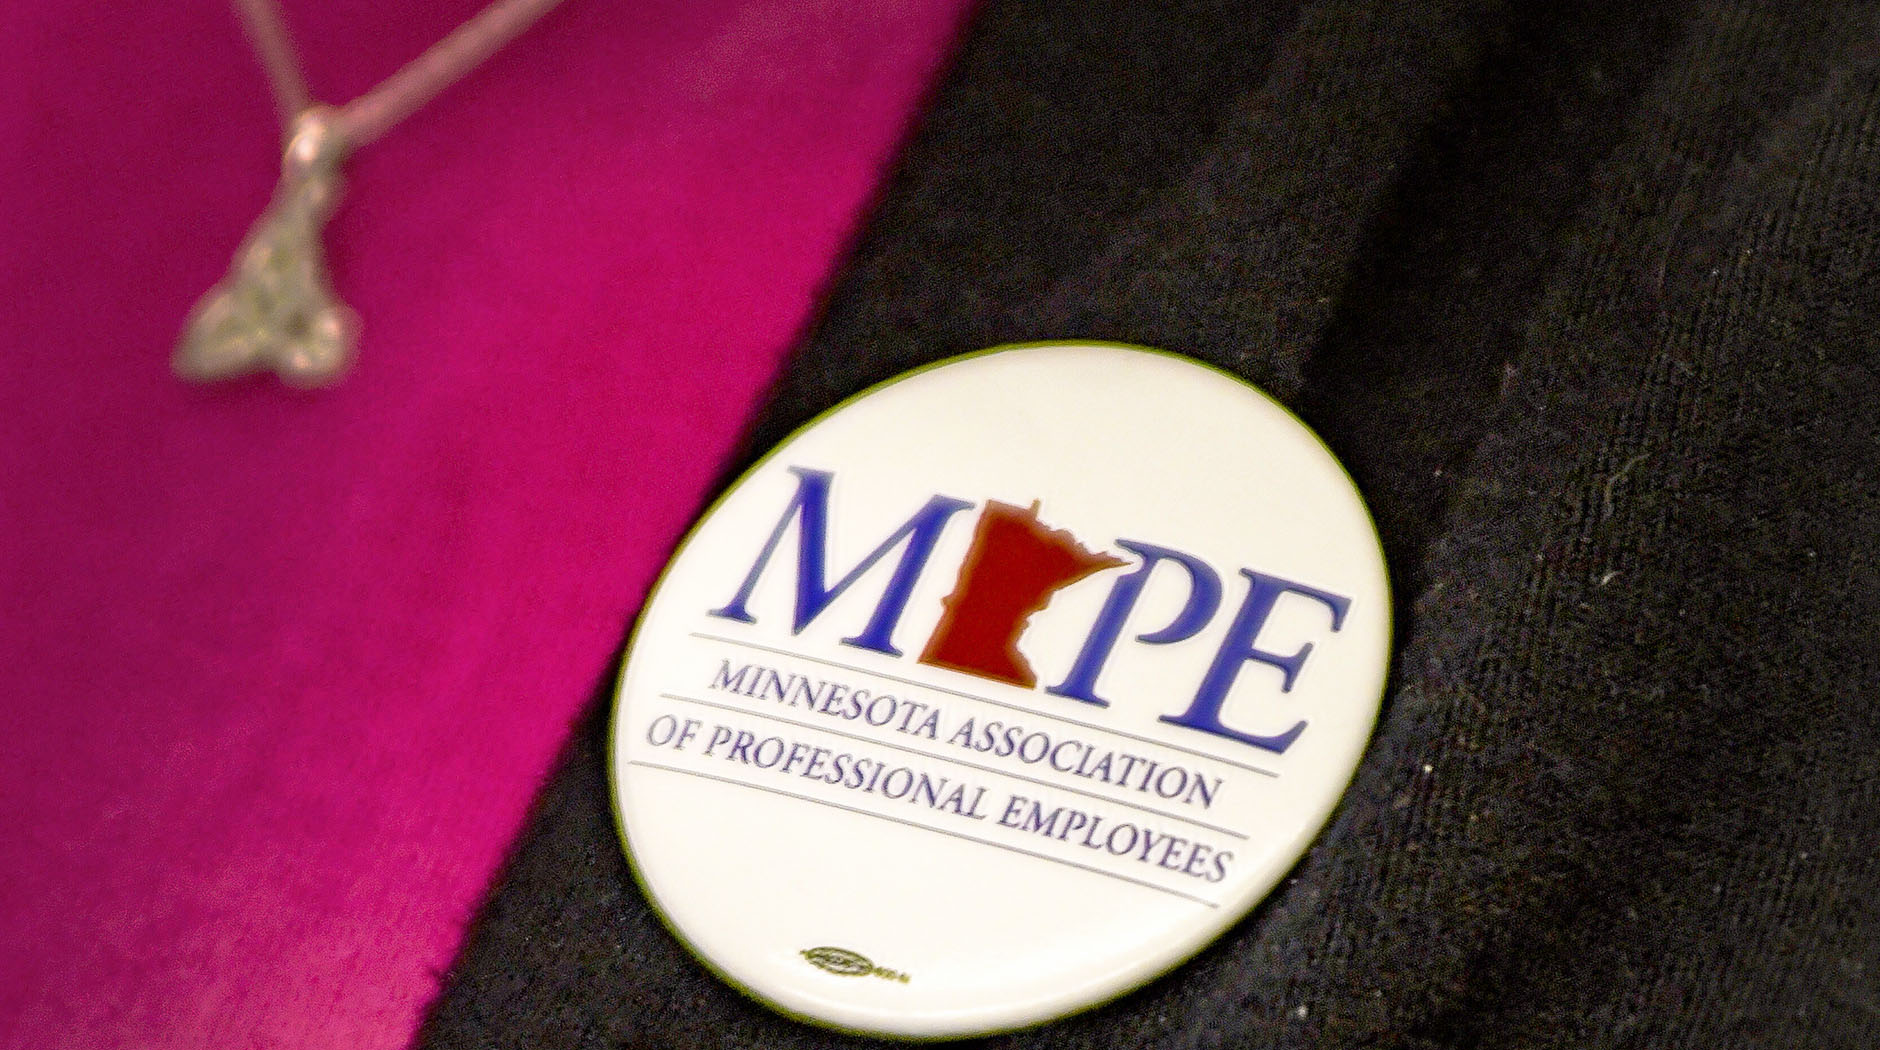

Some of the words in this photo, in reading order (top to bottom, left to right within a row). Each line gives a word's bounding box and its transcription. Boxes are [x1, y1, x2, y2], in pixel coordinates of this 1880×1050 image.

[646, 713, 704, 750] OF
[704, 728, 990, 822] PROFESSIONAL
[998, 794, 1235, 885] EMPLOYEES
[708, 658, 941, 741] MINNESOTA
[947, 716, 1225, 810] ASSOCIATION
